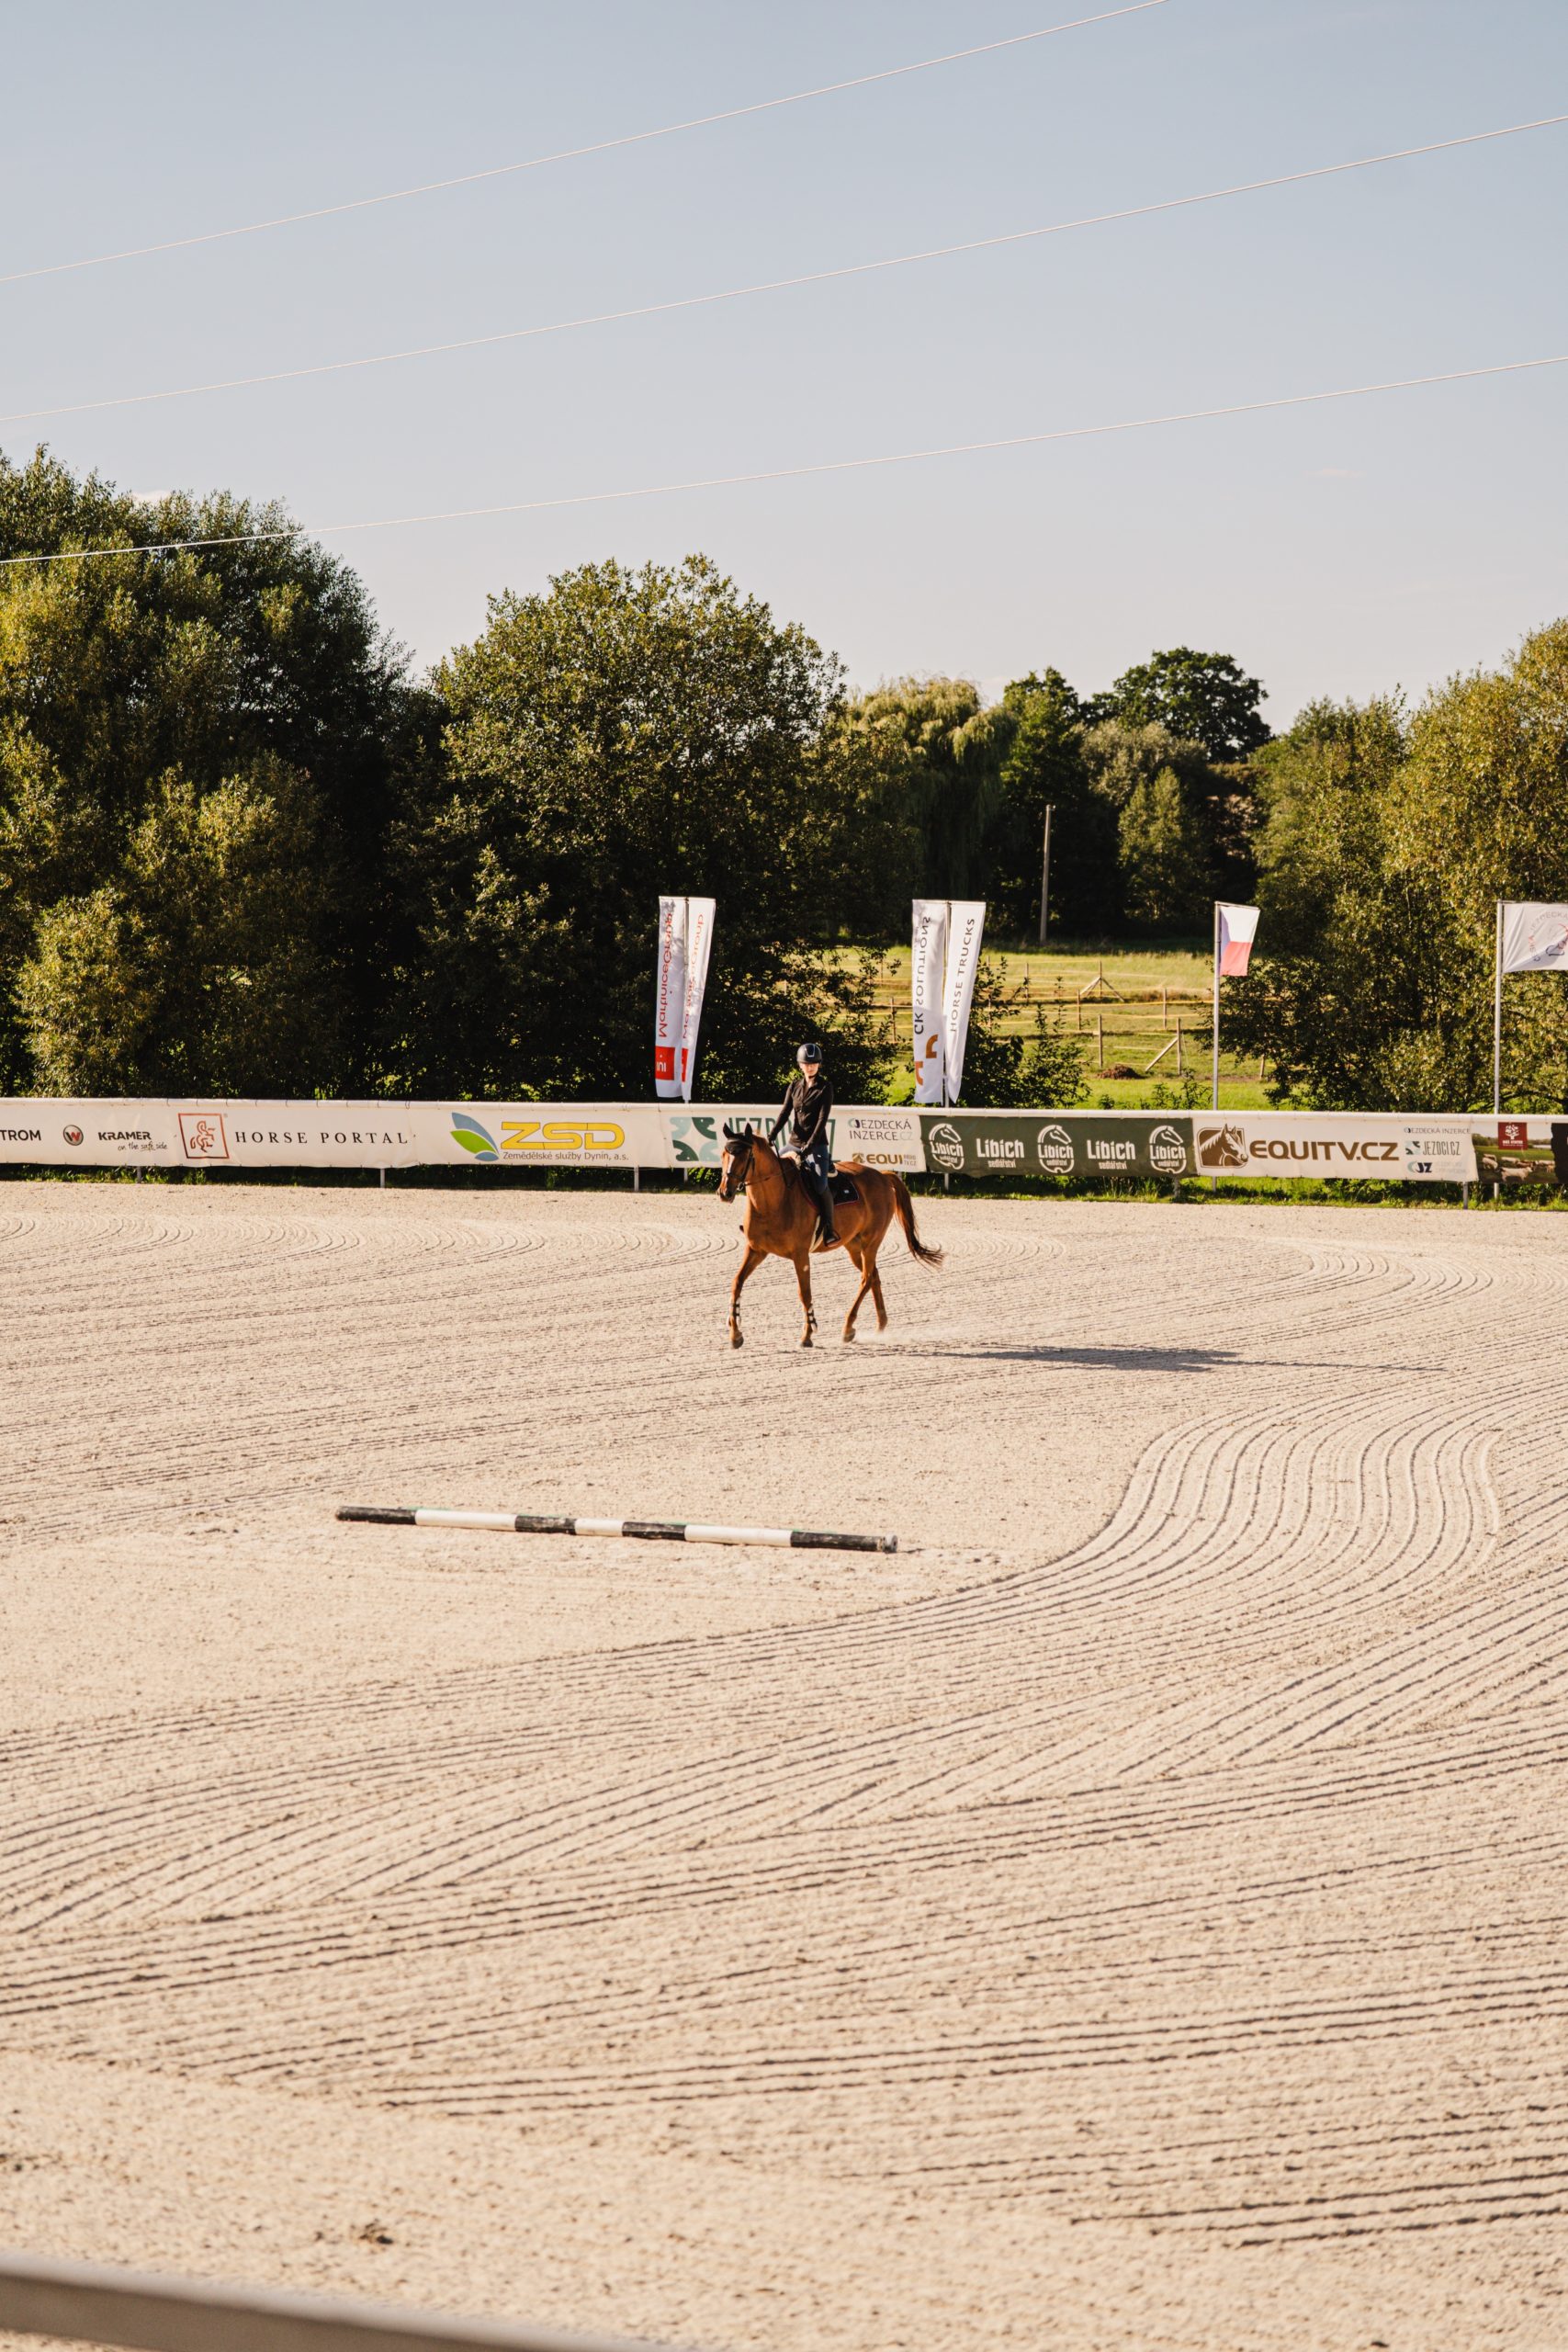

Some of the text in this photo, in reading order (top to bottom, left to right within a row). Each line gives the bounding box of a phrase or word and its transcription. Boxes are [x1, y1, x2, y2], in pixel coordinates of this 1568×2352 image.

[950, 918, 975, 1032] HORSE TRUCKS
[0, 1129, 41, 1141] TROM
[98, 1131, 152, 1140] KRAMER
[235, 1131, 408, 1144] HORSE PORTAL
[501, 1121, 625, 1149] ZSD
[555, 1151, 581, 1160] služby
[930, 1140, 964, 1158] Libich
[976, 1138, 1024, 1158] Libich
[1037, 1144, 1074, 1159] Libich
[1087, 1139, 1136, 1160] Libich
[1149, 1144, 1187, 1159] Libich
[1249, 1140, 1399, 1160] EQUITV.CZ
[866, 1153, 903, 1165] EQUI
